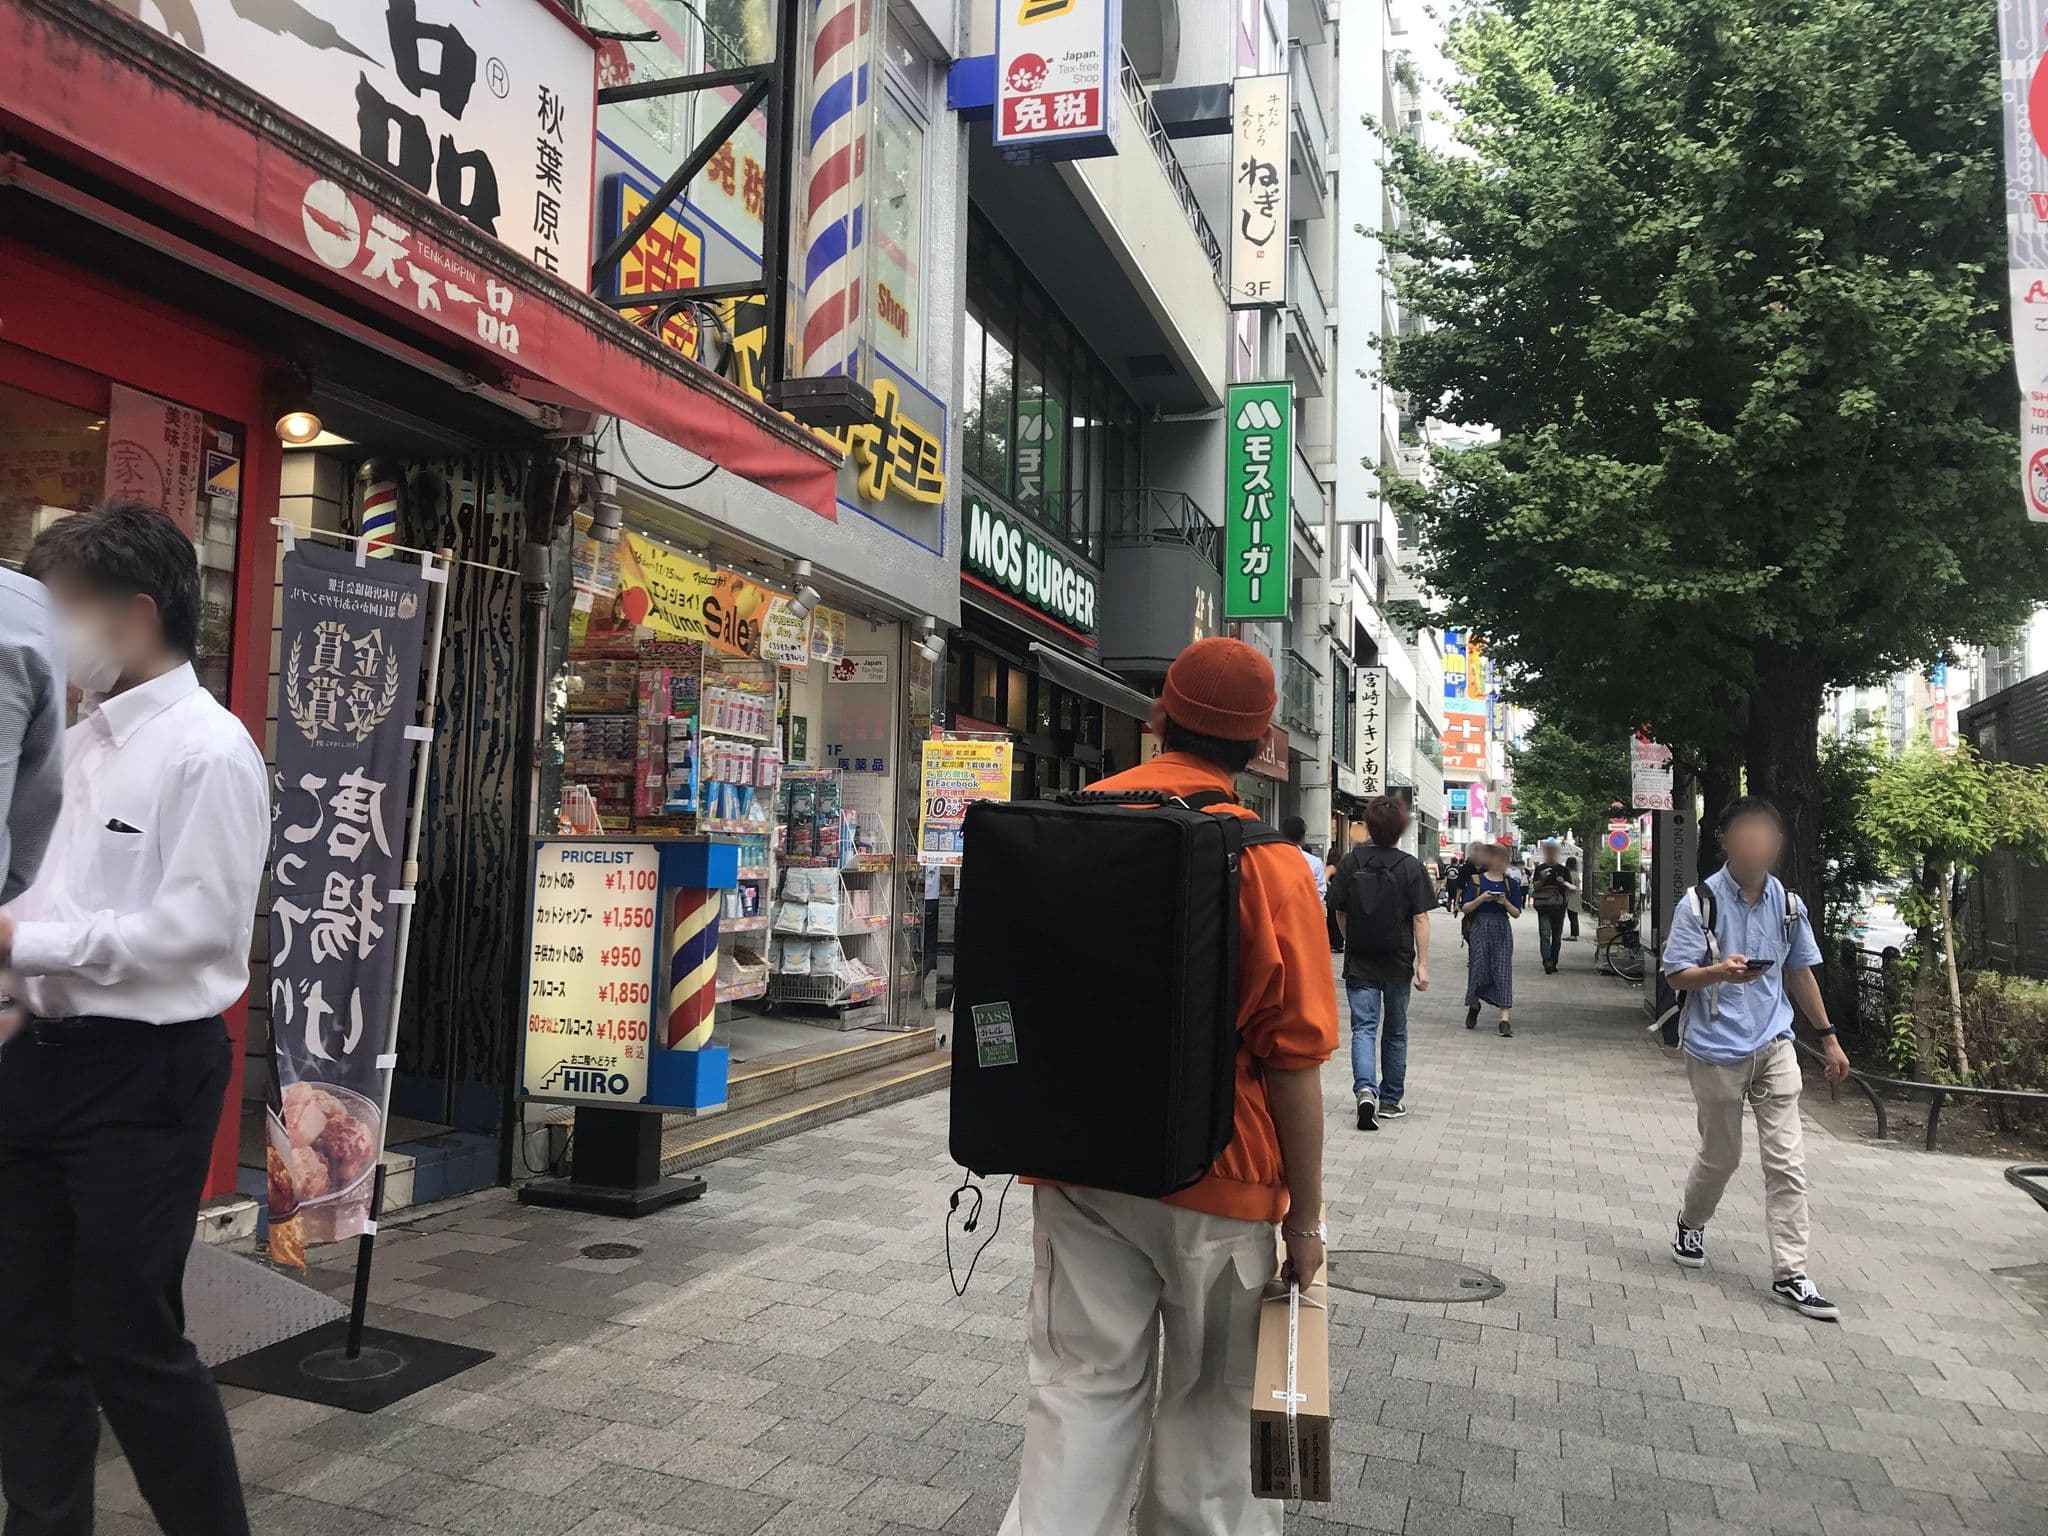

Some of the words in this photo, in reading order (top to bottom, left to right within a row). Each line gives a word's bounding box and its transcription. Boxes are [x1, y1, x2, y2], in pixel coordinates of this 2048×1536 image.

[1058, 62, 1099, 74] Tax-free
[1072, 73, 1099, 86] Shop
[1013, 92, 1088, 133] 免税
[1238, 154, 1281, 247] ねぎし
[416, 240, 476, 286] TENKAIPPIN
[362, 213, 520, 354] 天下一品
[1244, 280, 1272, 297] 3F
[1239, 434, 1274, 604] モスバーガー
[968, 503, 1023, 588] MOS
[1025, 544, 1095, 630] BURGER
[702, 595, 750, 654] Sale
[1361, 671, 1380, 794] 宮崎チキン南蛮
[826, 744, 843, 756] 1F
[838, 758, 884, 772] 医薬品
[935, 780, 979, 788] Facebook
[560, 850, 634, 865] PRICELIST
[1673, 827, 1685, 907] NFORMATION
[538, 871, 575, 890] カットのみ
[605, 869, 657, 894] ¥1,100
[602, 907, 654, 931] ¥1,550
[534, 943, 584, 965] 子供カットのみ
[600, 946, 641, 968] ¥950
[532, 980, 566, 998] フルコース
[598, 982, 650, 1006] ¥1,850
[975, 1010, 1010, 1025] PASS
[596, 1019, 648, 1045] ¥1,650
[563, 1069, 629, 1095] HIRO
